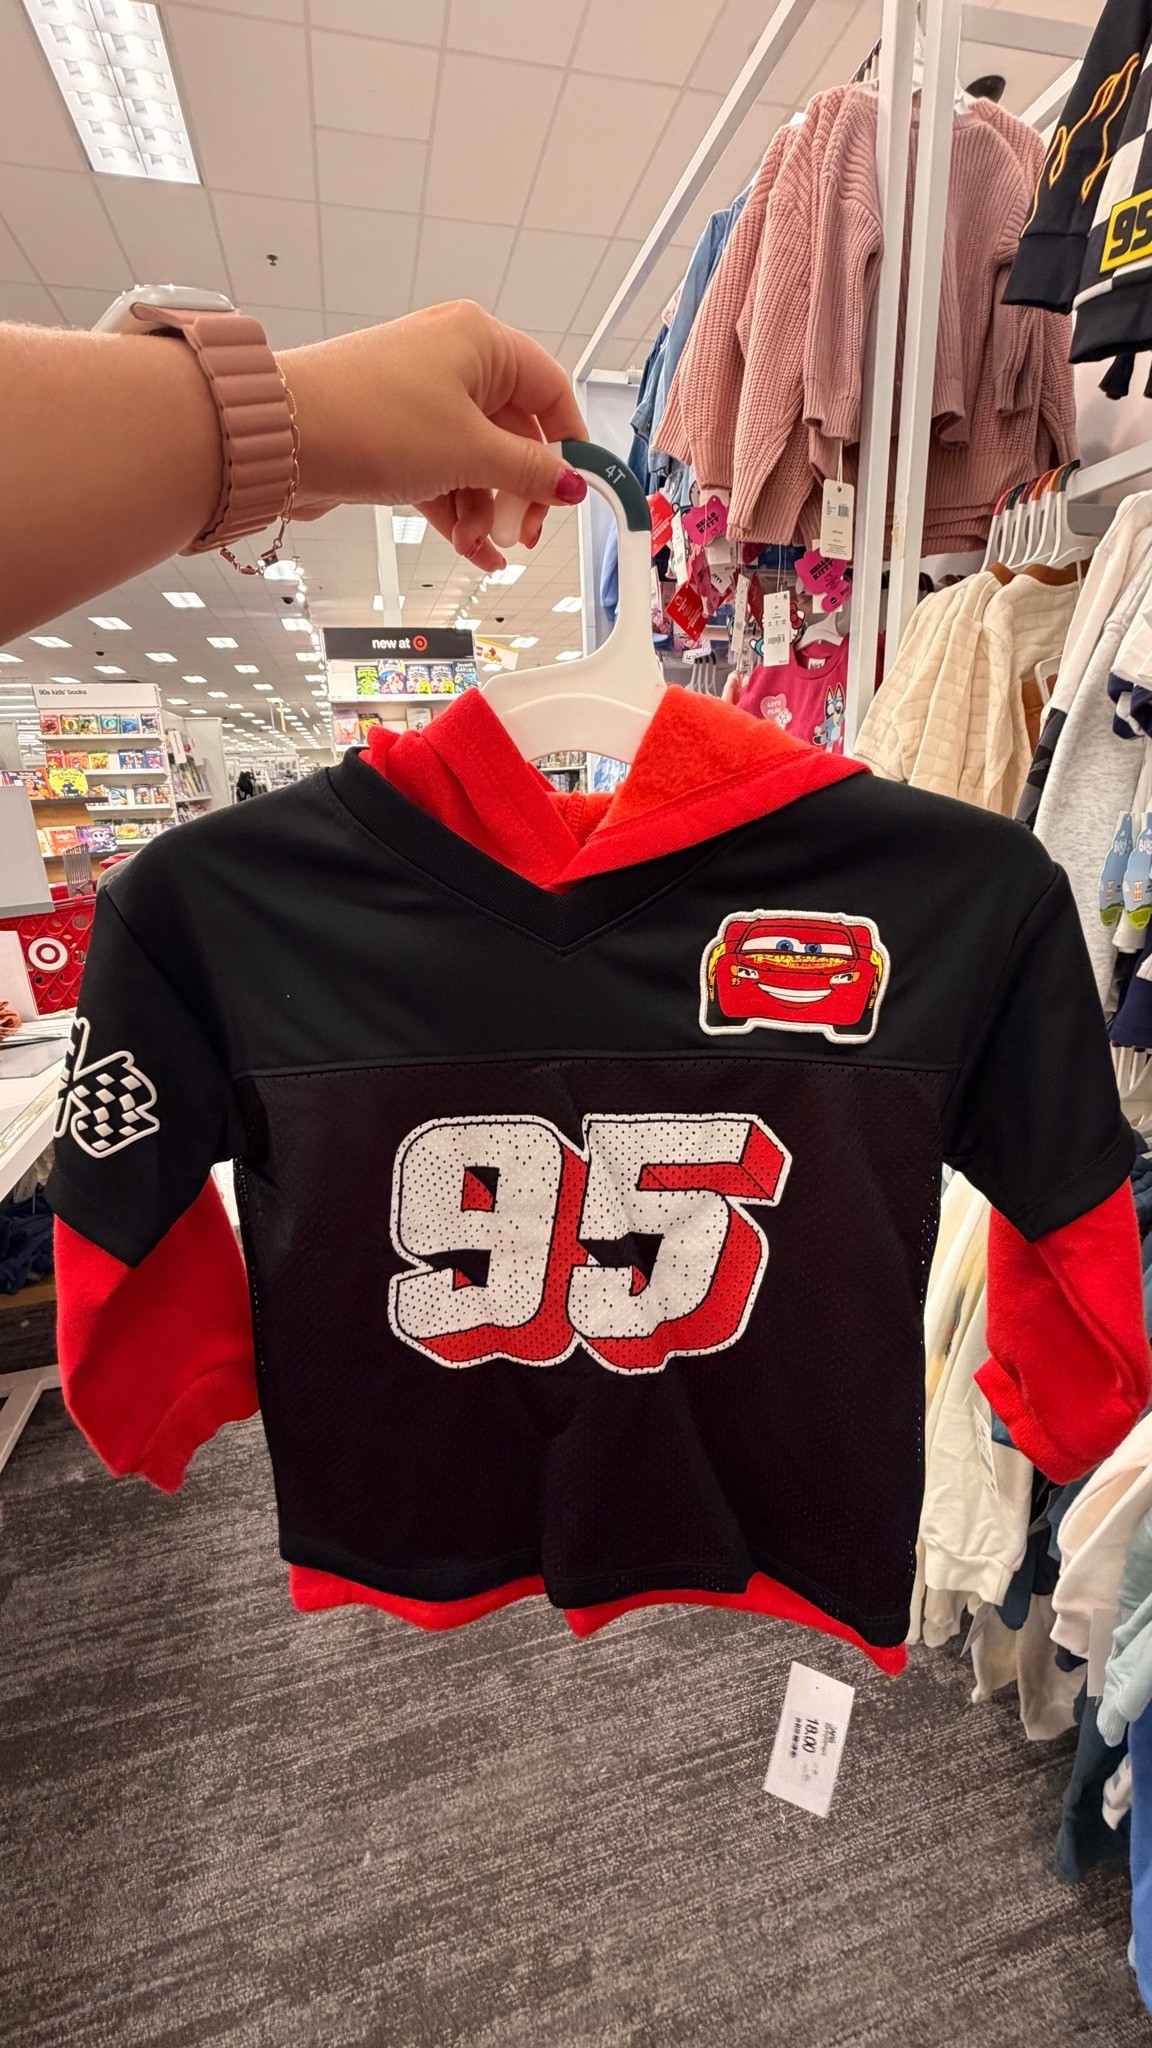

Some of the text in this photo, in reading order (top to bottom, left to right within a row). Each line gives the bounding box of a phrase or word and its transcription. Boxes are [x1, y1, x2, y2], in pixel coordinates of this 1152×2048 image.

[1107, 198, 1152, 261] 95
[605, 464, 626, 484] 4T
[695, 511, 716, 529] HELLO
[698, 515, 719, 534] KITTY
[812, 560, 834, 581] KITTY
[371, 637, 411, 649] new at
[730, 977, 742, 987] 95
[388, 1112, 793, 1376] 95
